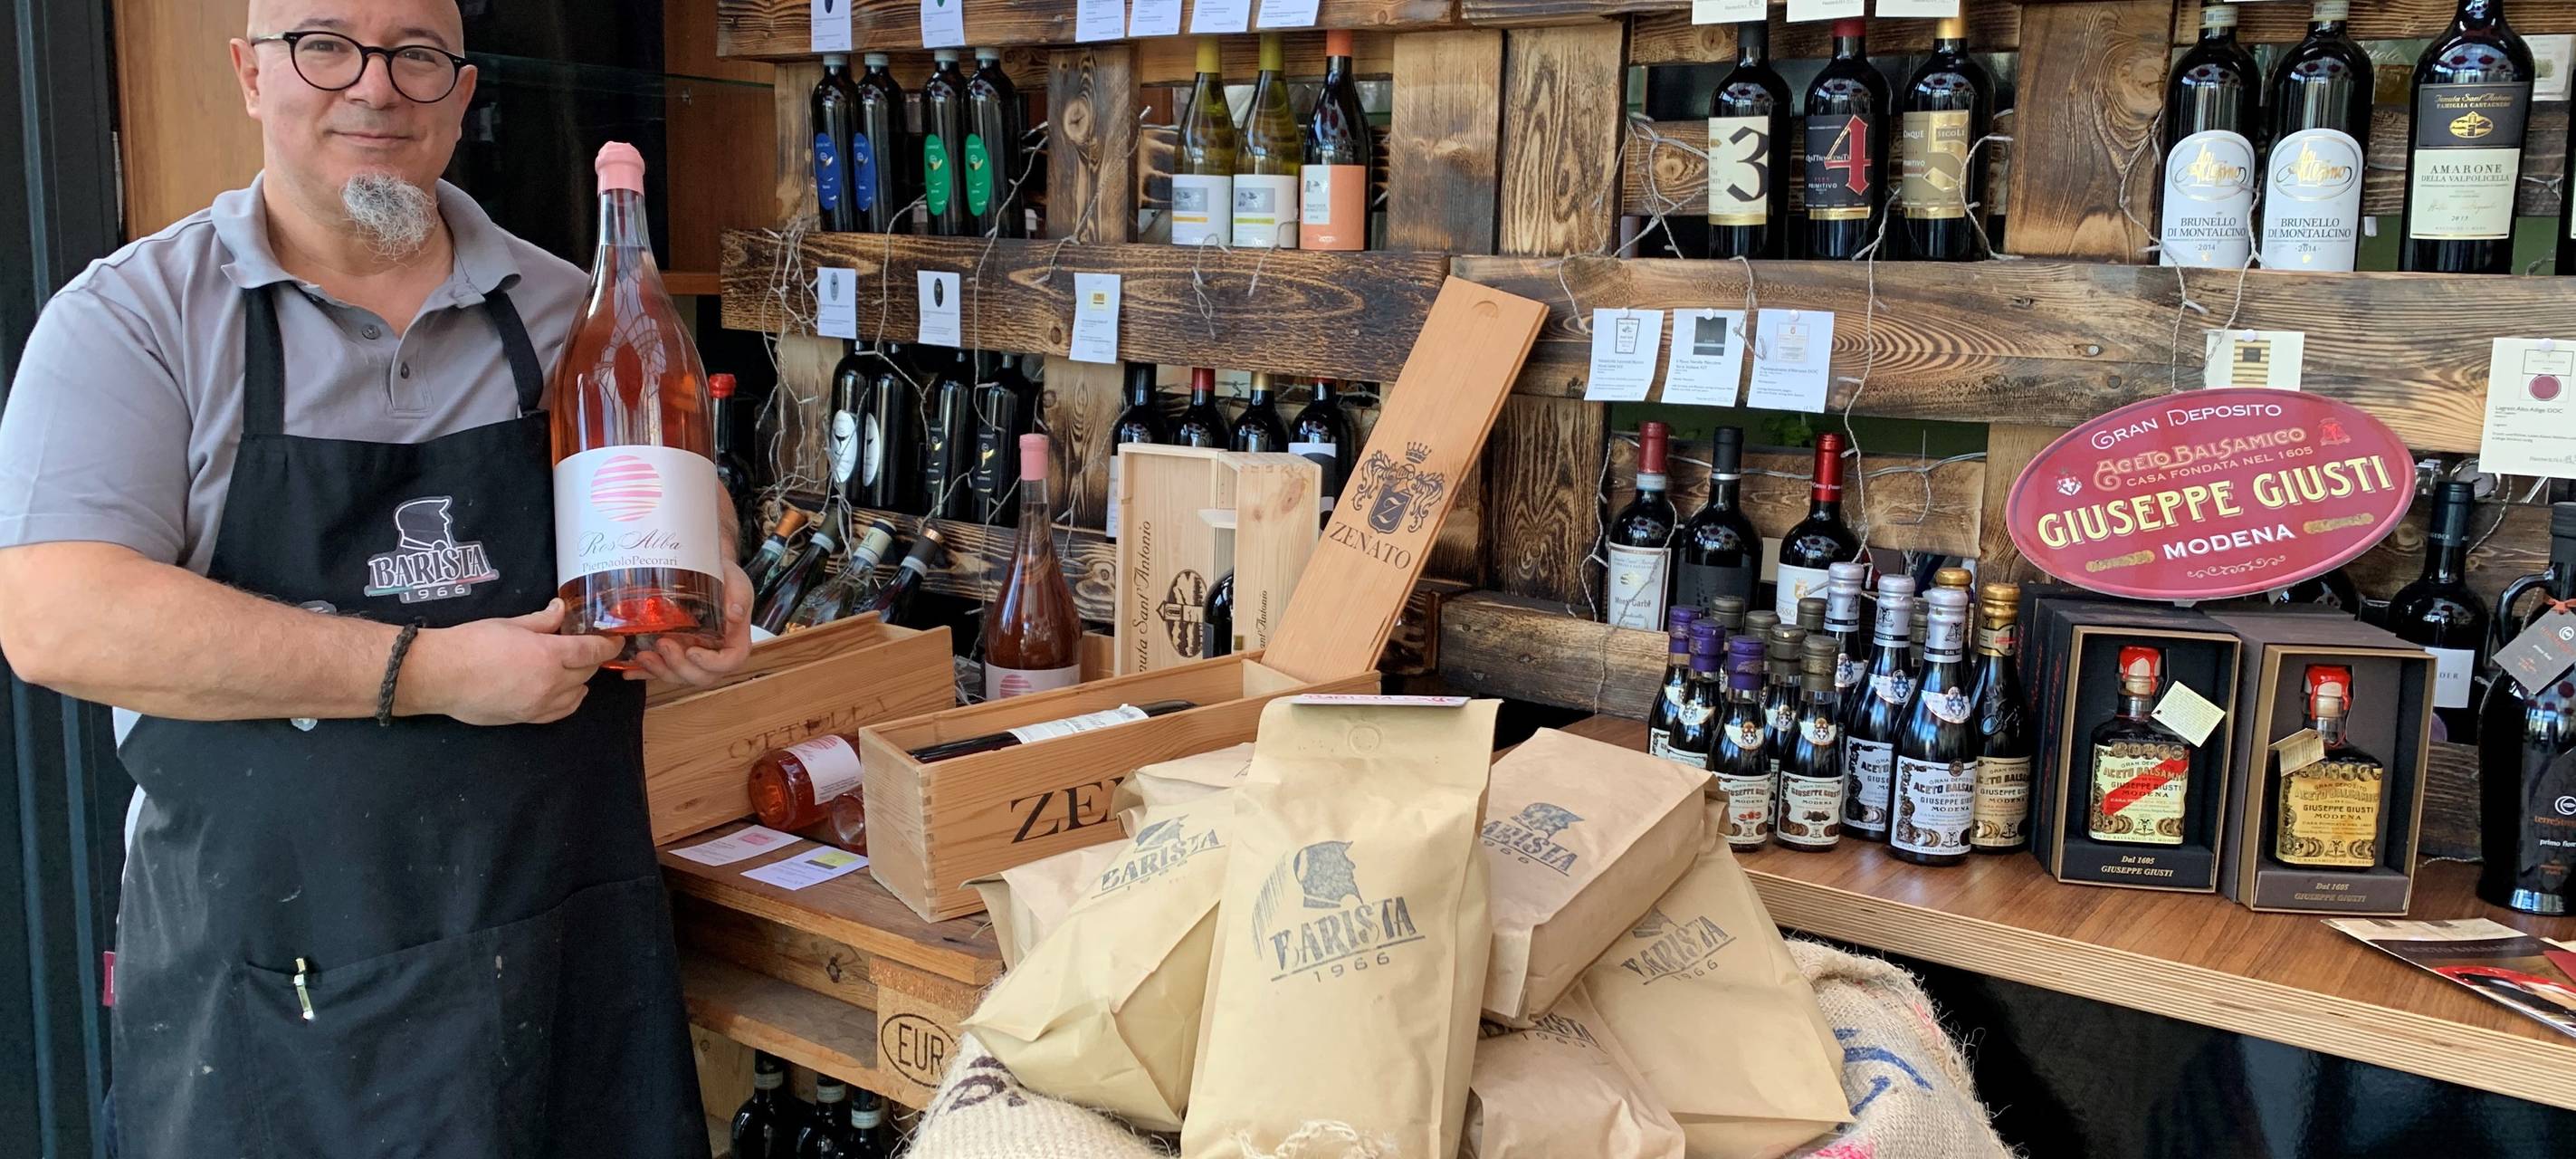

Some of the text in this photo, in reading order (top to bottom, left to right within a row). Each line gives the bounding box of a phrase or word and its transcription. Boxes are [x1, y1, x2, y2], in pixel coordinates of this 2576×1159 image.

[1825, 114, 1872, 196] 4
[1727, 126, 1768, 202] 3
[2430, 164, 2502, 174] AMARONE
[2180, 217, 2237, 226] BRUNELLO
[2281, 218, 2340, 227] BRUNELLO
[2168, 228, 2247, 237] DI MONTALCINO
[2268, 228, 2352, 237] DI MONTALCINO
[2127, 446, 2314, 487] CASA FONDATA NEL 1605
[2037, 455, 2395, 549] GIUSEPPE GIUSTI
[1330, 522, 1411, 570] ZENATO
[2163, 524, 2295, 560] MODENA
[368, 545, 490, 589] BARISTA
[404, 585, 466, 601] 1966
[1913, 781, 1943, 794] ACETO
[2111, 781, 2182, 791] GIUSEPPE GIUSTI
[1790, 788, 1823, 798] GIUSEPPE
[1980, 788, 2017, 798] GIUSEPPE
[2122, 789, 2169, 798] MODENA
[1920, 796, 1958, 806] GIUSEPPE
[1011, 778, 1123, 844] ZE
[2303, 804, 2343, 812] GIUSEPPE
[2540, 838, 2561, 848] primo
[1484, 840, 1529, 864] 966
[1101, 829, 1221, 892] BARISTA
[2122, 856, 2136, 864] Dal
[2101, 866, 2174, 877] GIUSEPPE GIUSTI
[2315, 882, 2330, 890] Dal
[2295, 892, 2367, 903] GIUSEPPE GIUSTI
[1314, 952, 1390, 982] 1966
[1673, 959, 1718, 982] 1966
[899, 1023, 944, 1079] EUR
